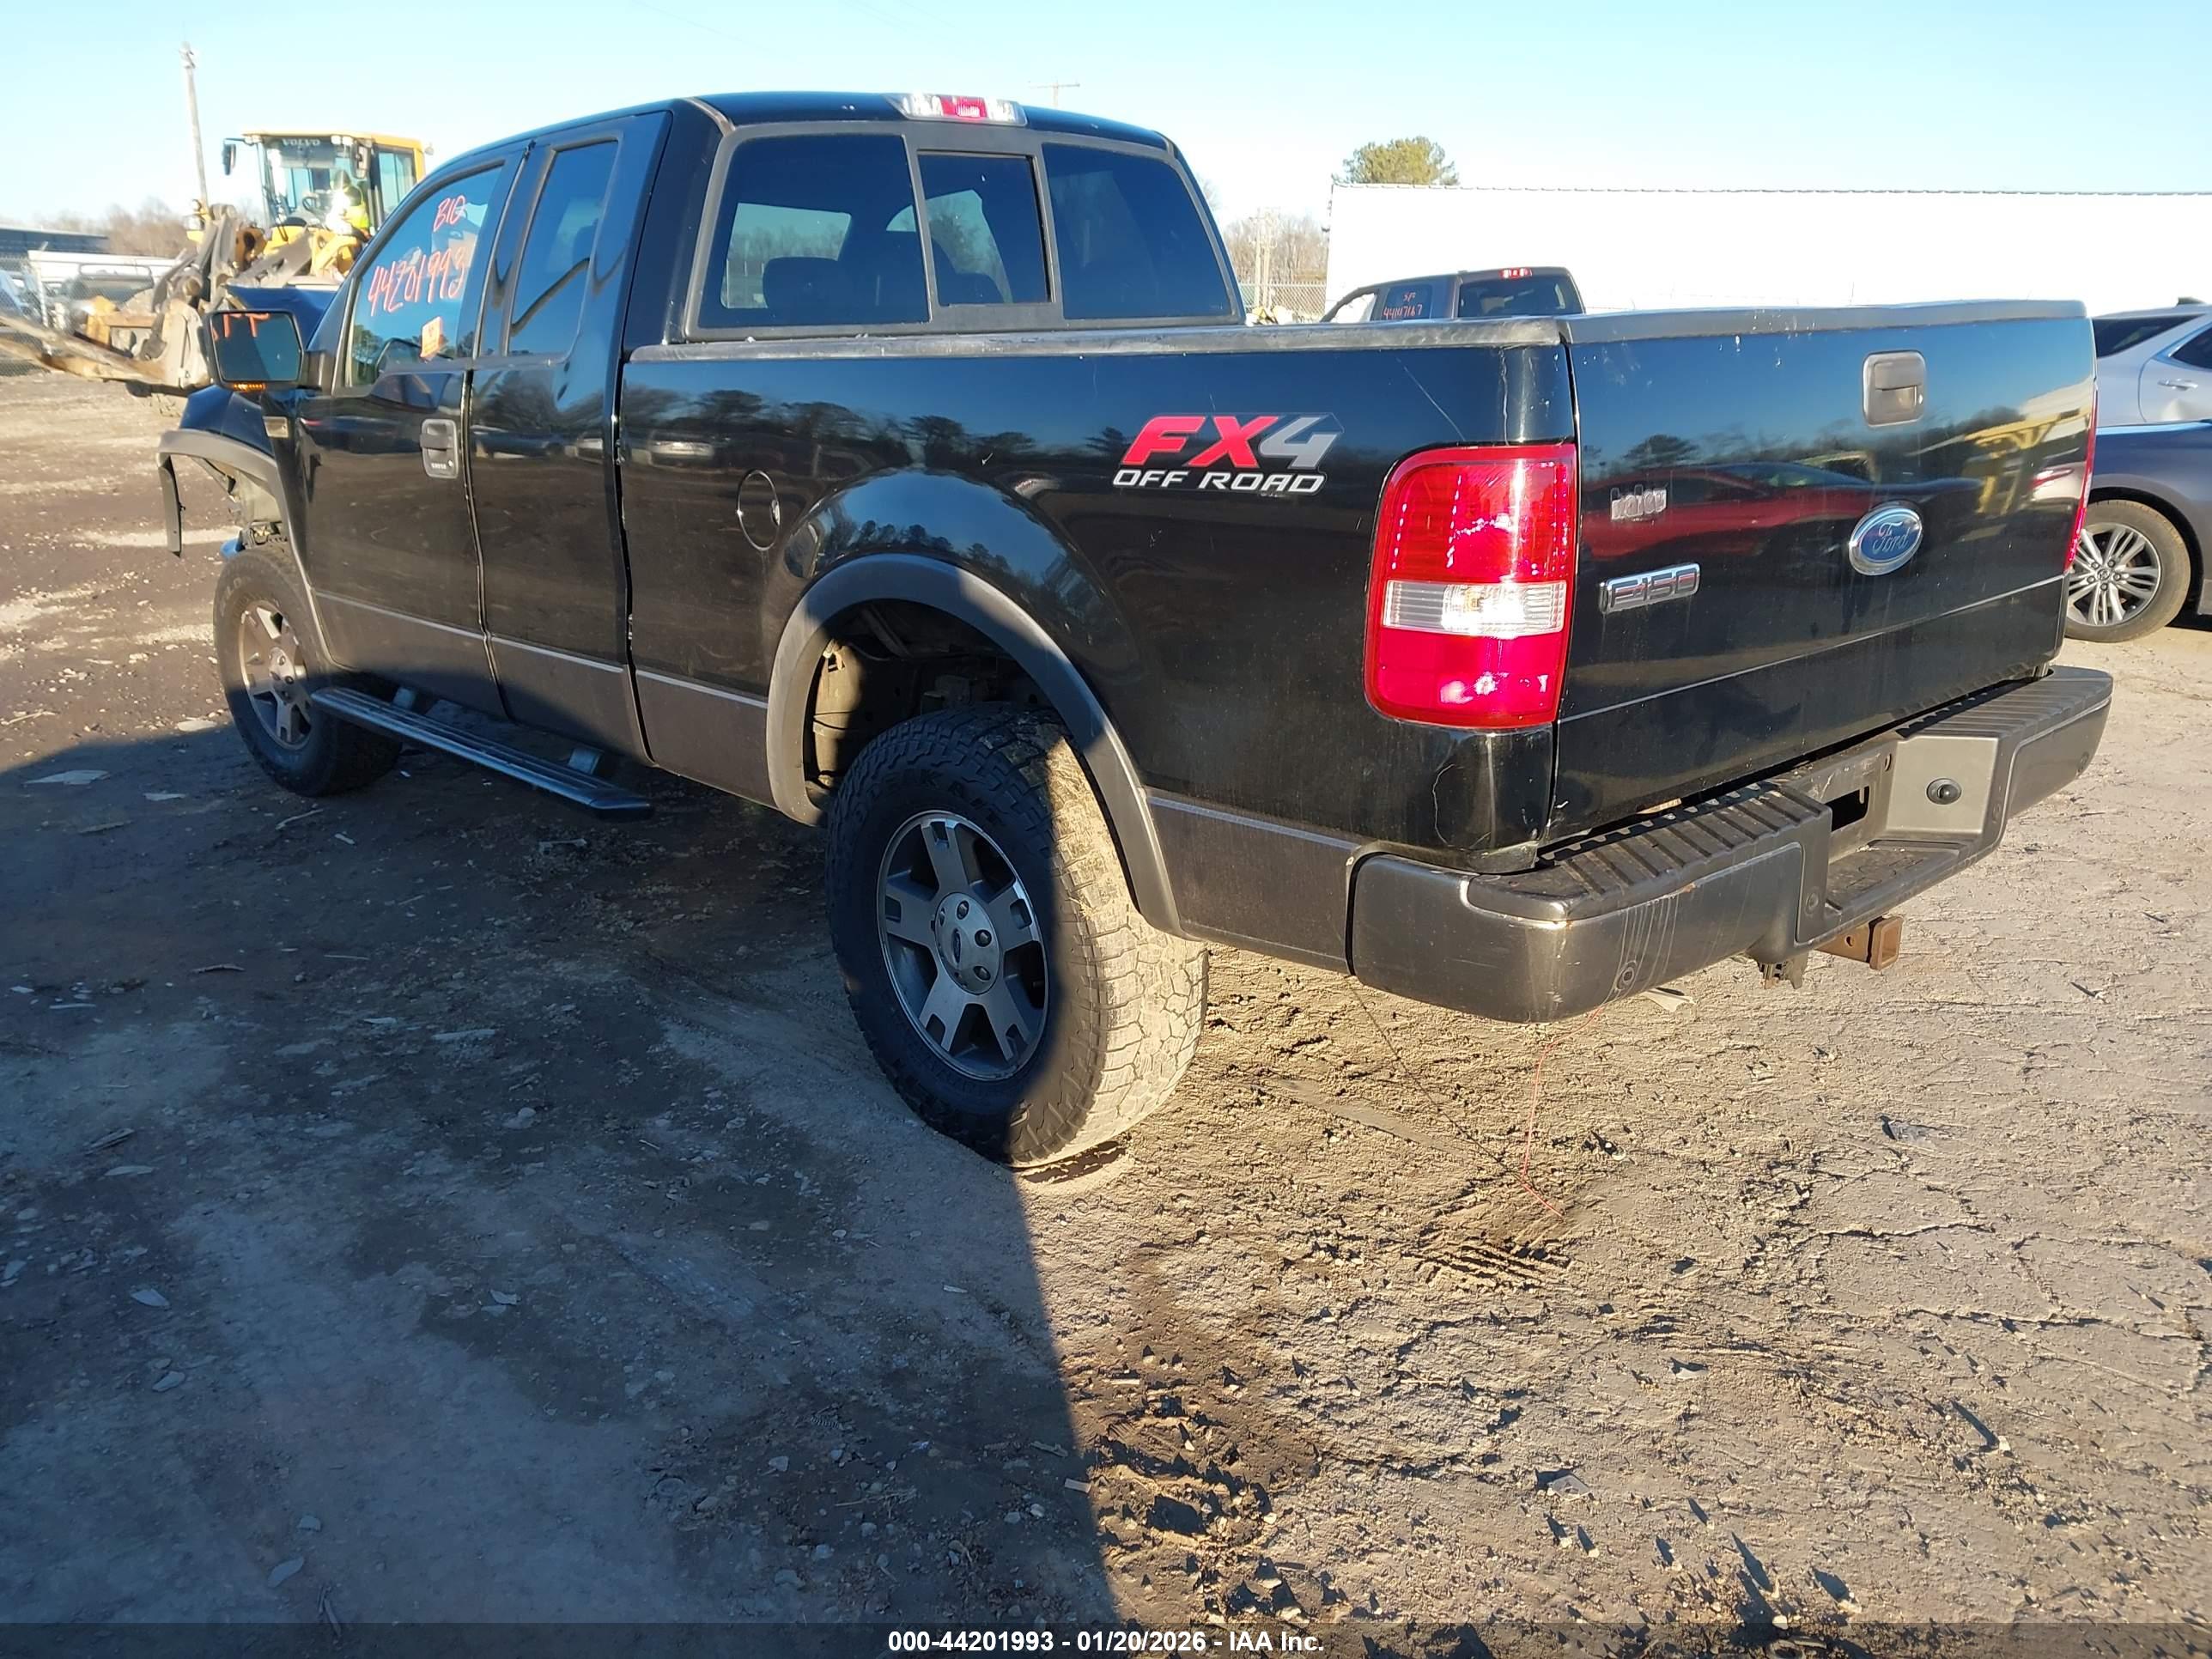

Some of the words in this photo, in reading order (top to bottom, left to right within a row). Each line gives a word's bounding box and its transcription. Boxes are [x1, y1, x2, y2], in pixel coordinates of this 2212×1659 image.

[282, 138, 320, 147] VOLVO
[368, 246, 466, 317] 44201993
[1120, 416, 1338, 469] FX4
[1113, 469, 1188, 488] OFF
[1199, 471, 1325, 493] ROAD
[1873, 521, 1911, 555] Ford
